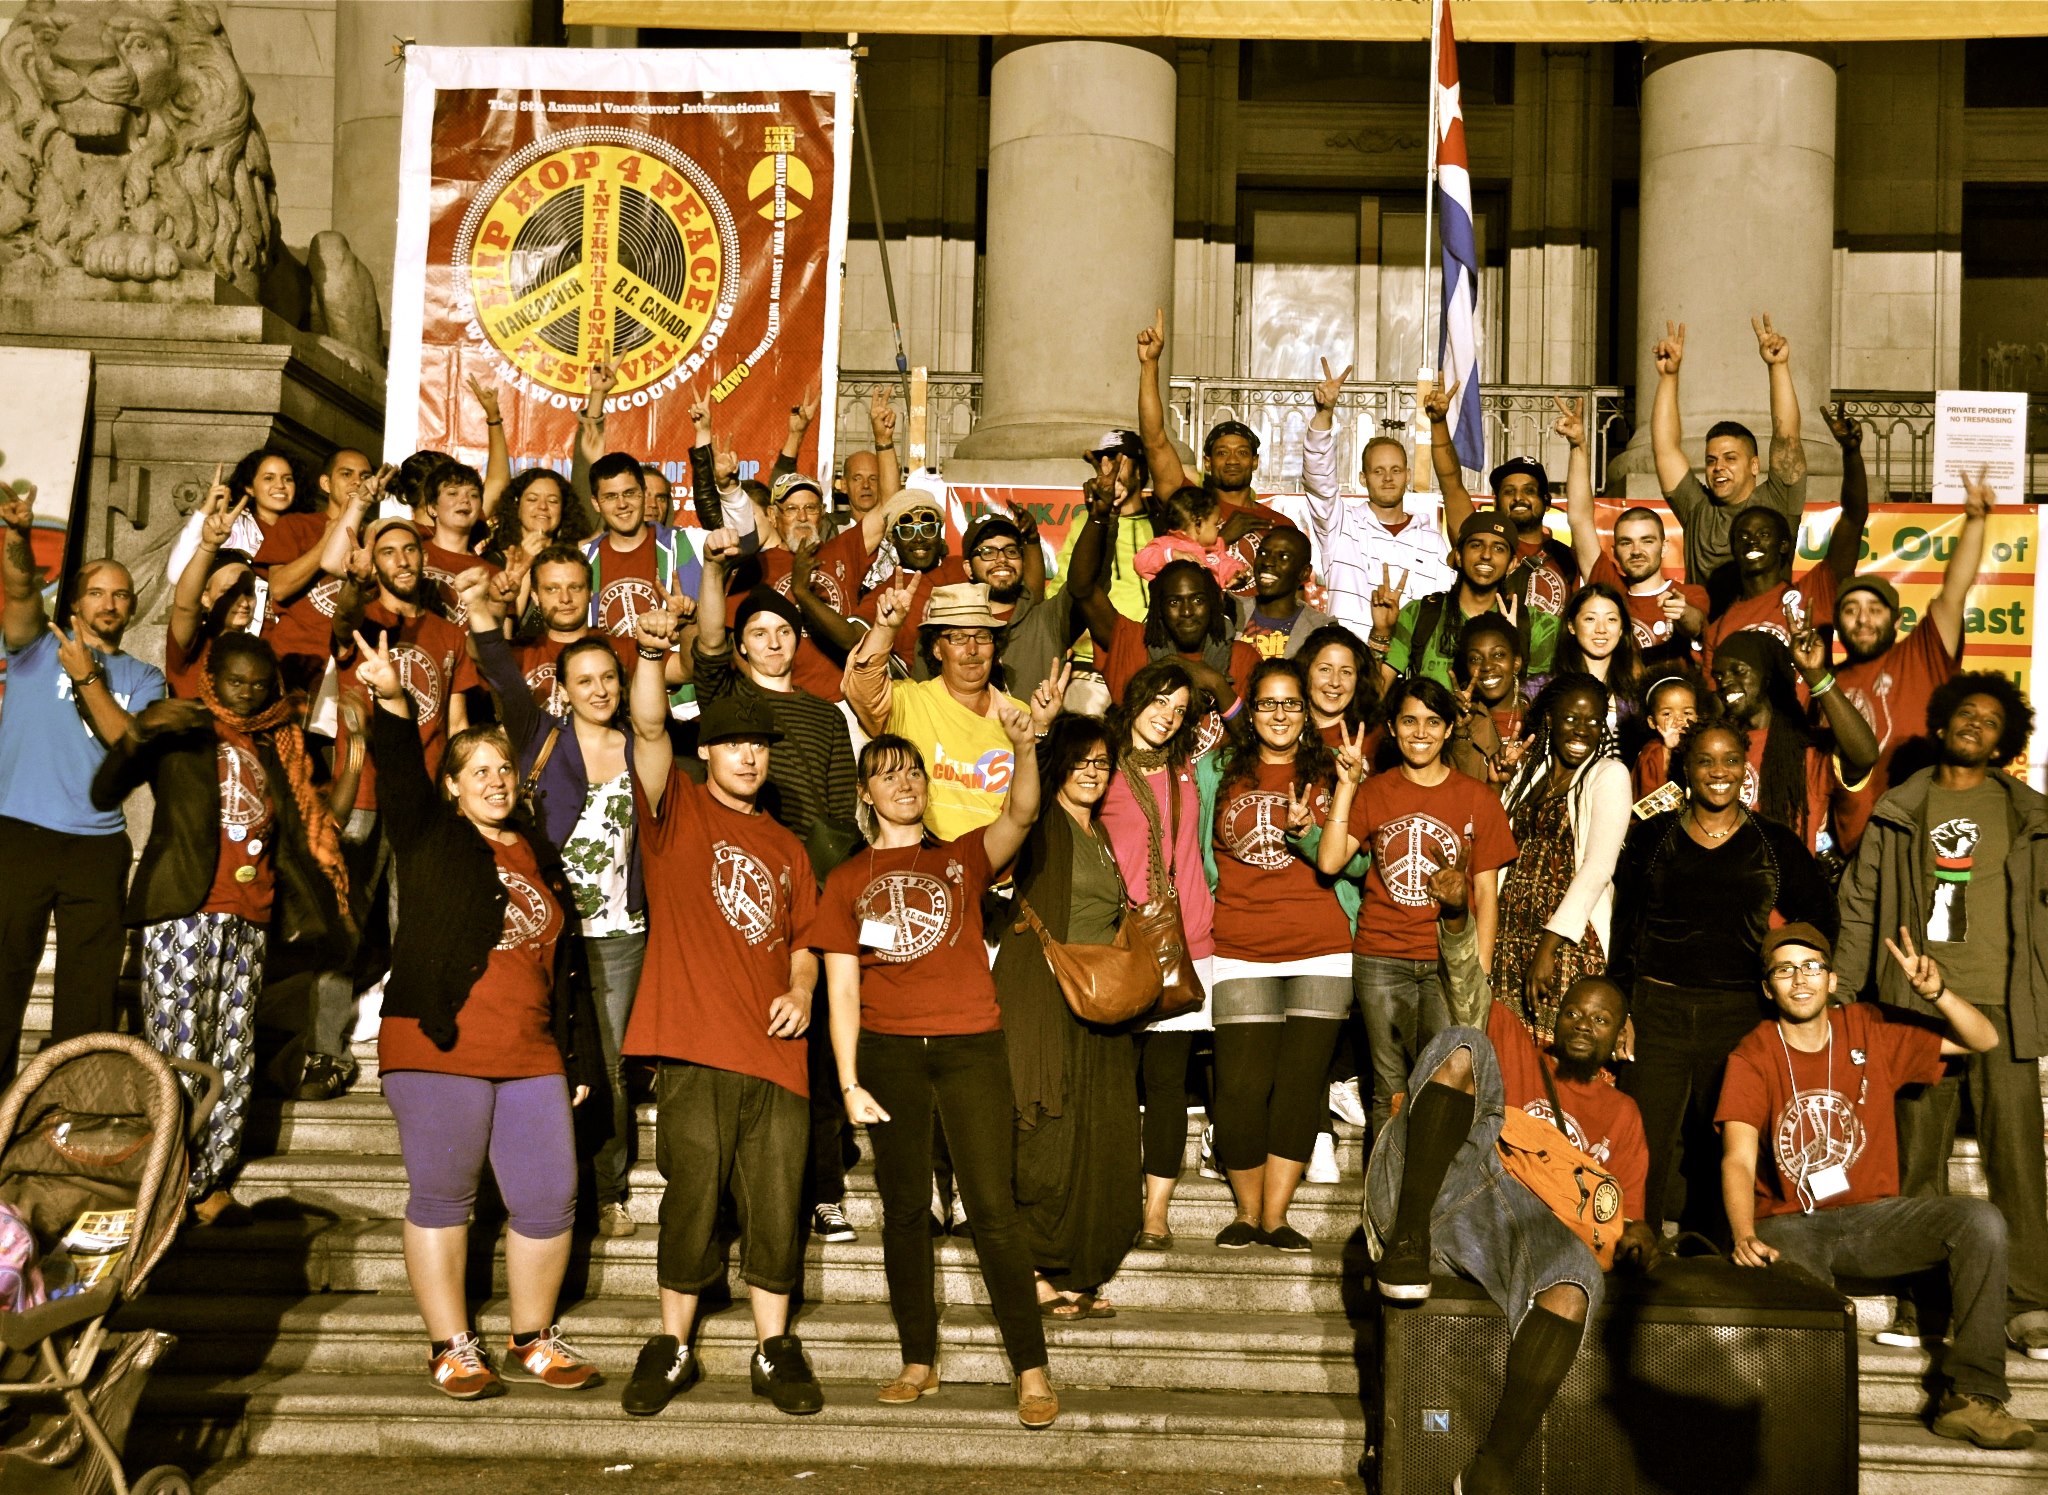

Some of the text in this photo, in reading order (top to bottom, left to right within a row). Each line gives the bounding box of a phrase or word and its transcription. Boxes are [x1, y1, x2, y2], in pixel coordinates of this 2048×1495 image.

[488, 100, 780, 115] The 8th Annual Vancouver International
[764, 127, 795, 136] FREE
[764, 144, 795, 153] AGES
[775, 154, 787, 218] OCCUPATION
[476, 151, 717, 314] HIP HOP 4 PEACE
[587, 180, 611, 366] INTERNATIONAL
[770, 258, 785, 300] AGAINST
[494, 277, 585, 340] VANCOUVER
[612, 277, 693, 344] B.C. CANADA
[745, 301, 780, 368] MOBILIZATION
[456, 298, 735, 415] WWW.MAWOVNCOUVER.ORG
[514, 337, 681, 387] FESTVAL
[710, 363, 751, 404] MAWO
[1946, 406, 2017, 415] PRIVATE PROPERTY
[1963, 416, 2013, 424] TRESPASSING
[738, 460, 760, 481] OP
[1892, 526, 1960, 562] Ou
[1991, 536, 2029, 562] of
[1543, 572, 1561, 607] PEACE
[1964, 601, 2025, 636] ast
[933, 752, 1011, 793] CUAN 5
[1242, 850, 1289, 862] FESTIV
[1385, 819, 1415, 839] HOP
[1430, 828, 1456, 862] PEAC
[1410, 828, 1418, 890] INTERNATIONAL
[516, 883, 545, 927] PEACE
[913, 879, 944, 917] PEACE
[1388, 880, 1428, 897] FESTI
[894, 928, 936, 953] STIVAL
[917, 914, 939, 929] CANADA
[1534, 1105, 1554, 1119] OP
[1780, 1126, 1795, 1160] HIP
[1815, 1098, 1825, 1107] 4
